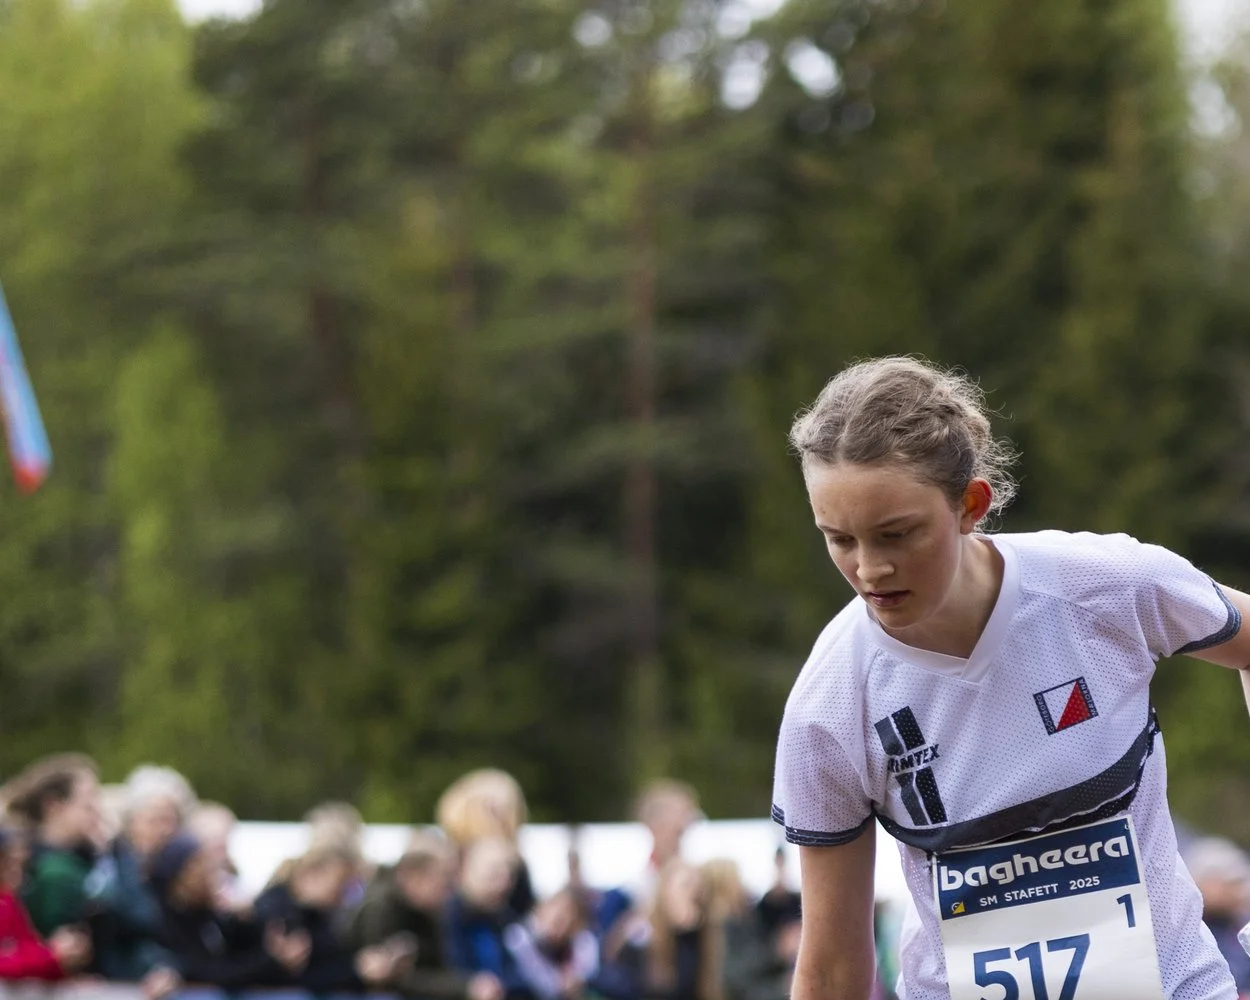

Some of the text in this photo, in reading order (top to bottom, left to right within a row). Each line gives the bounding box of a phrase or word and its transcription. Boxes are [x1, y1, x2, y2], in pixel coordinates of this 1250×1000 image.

[940, 836, 1130, 892] bagheera
[979, 876, 1100, 907] SM STAFETT 2025
[1116, 893, 1136, 928] 1
